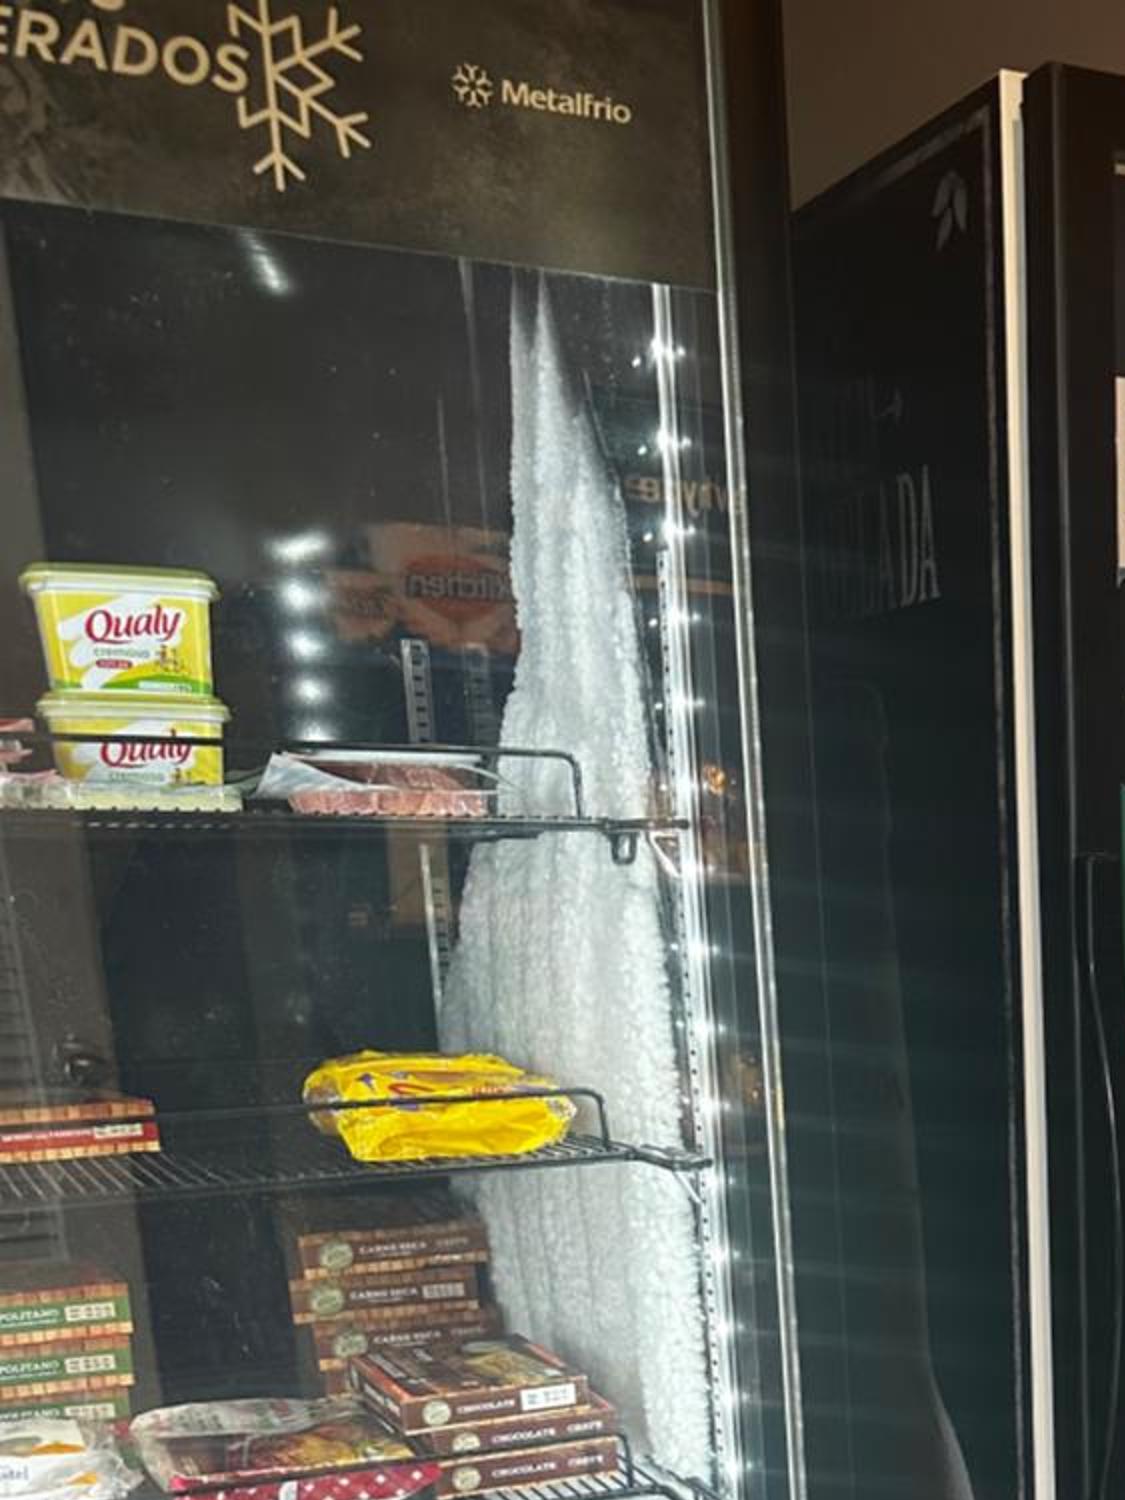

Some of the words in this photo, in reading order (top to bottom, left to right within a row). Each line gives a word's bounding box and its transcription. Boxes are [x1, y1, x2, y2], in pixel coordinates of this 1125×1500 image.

[502, 79, 631, 124] Metalfrio
[85, 604, 181, 645] Qualy
[99, 727, 193, 769] Qualy
